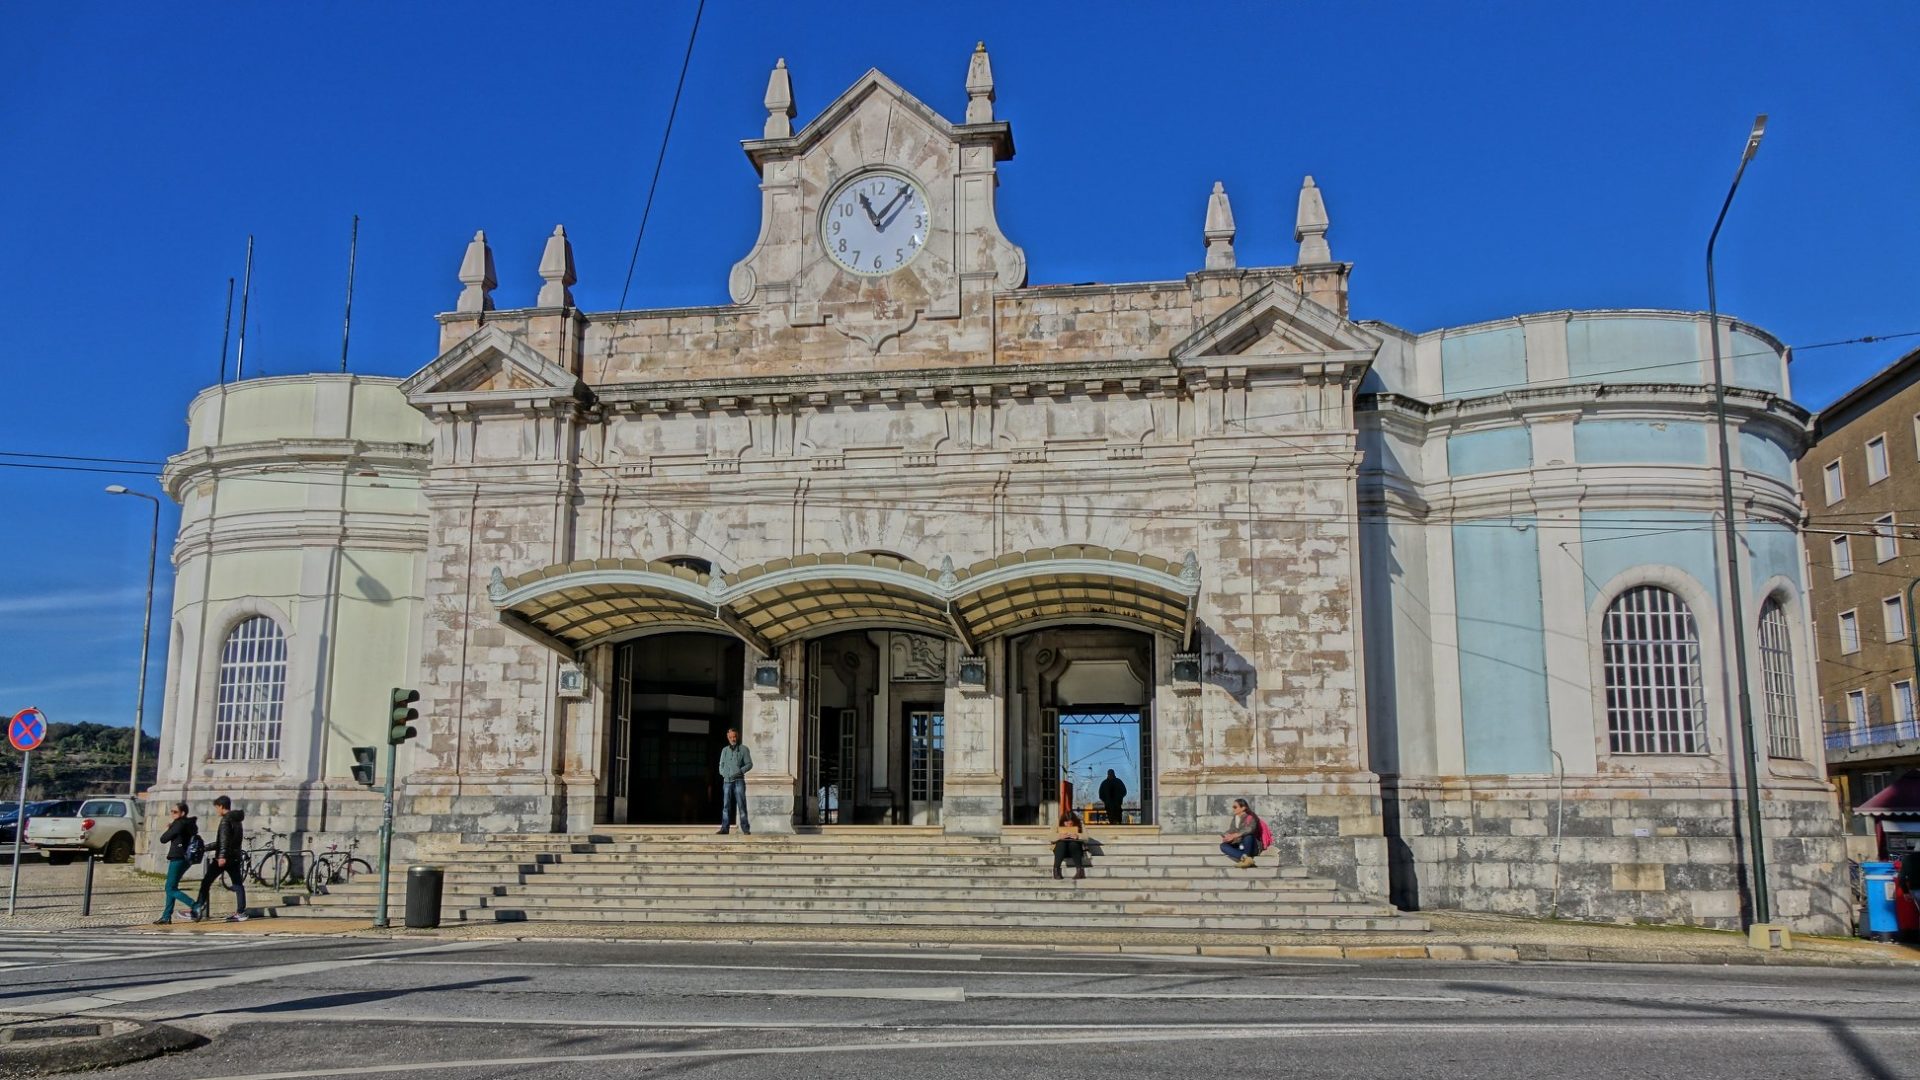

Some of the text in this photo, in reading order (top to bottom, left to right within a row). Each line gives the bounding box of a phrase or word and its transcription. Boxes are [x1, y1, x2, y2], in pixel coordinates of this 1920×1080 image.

[870, 182, 885, 195] 12
[839, 204, 853, 217] 10
[832, 221, 840, 235] 9
[915, 215, 922, 228] 3
[839, 239, 847, 252] 8
[908, 235, 916, 249] 4
[852, 251, 860, 265] 7
[874, 255, 882, 269] 6
[896, 249, 903, 262] 5
